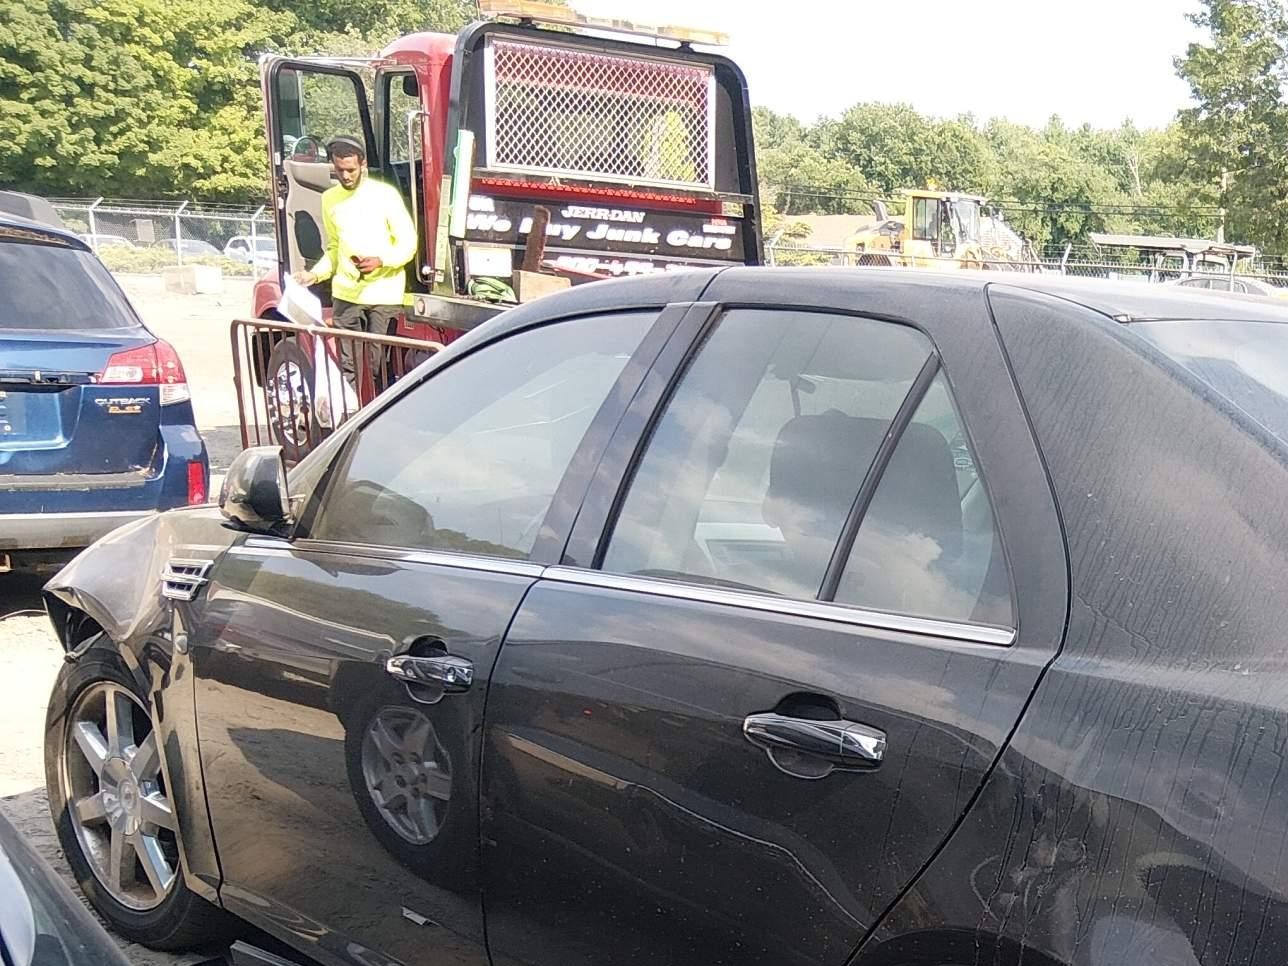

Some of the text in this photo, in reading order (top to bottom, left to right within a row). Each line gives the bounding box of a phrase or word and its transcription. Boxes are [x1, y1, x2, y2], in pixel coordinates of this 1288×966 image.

[586, 224, 661, 244] Junk
[666, 230, 732, 250] Cars
[94, 397, 151, 406] OUTBACK
